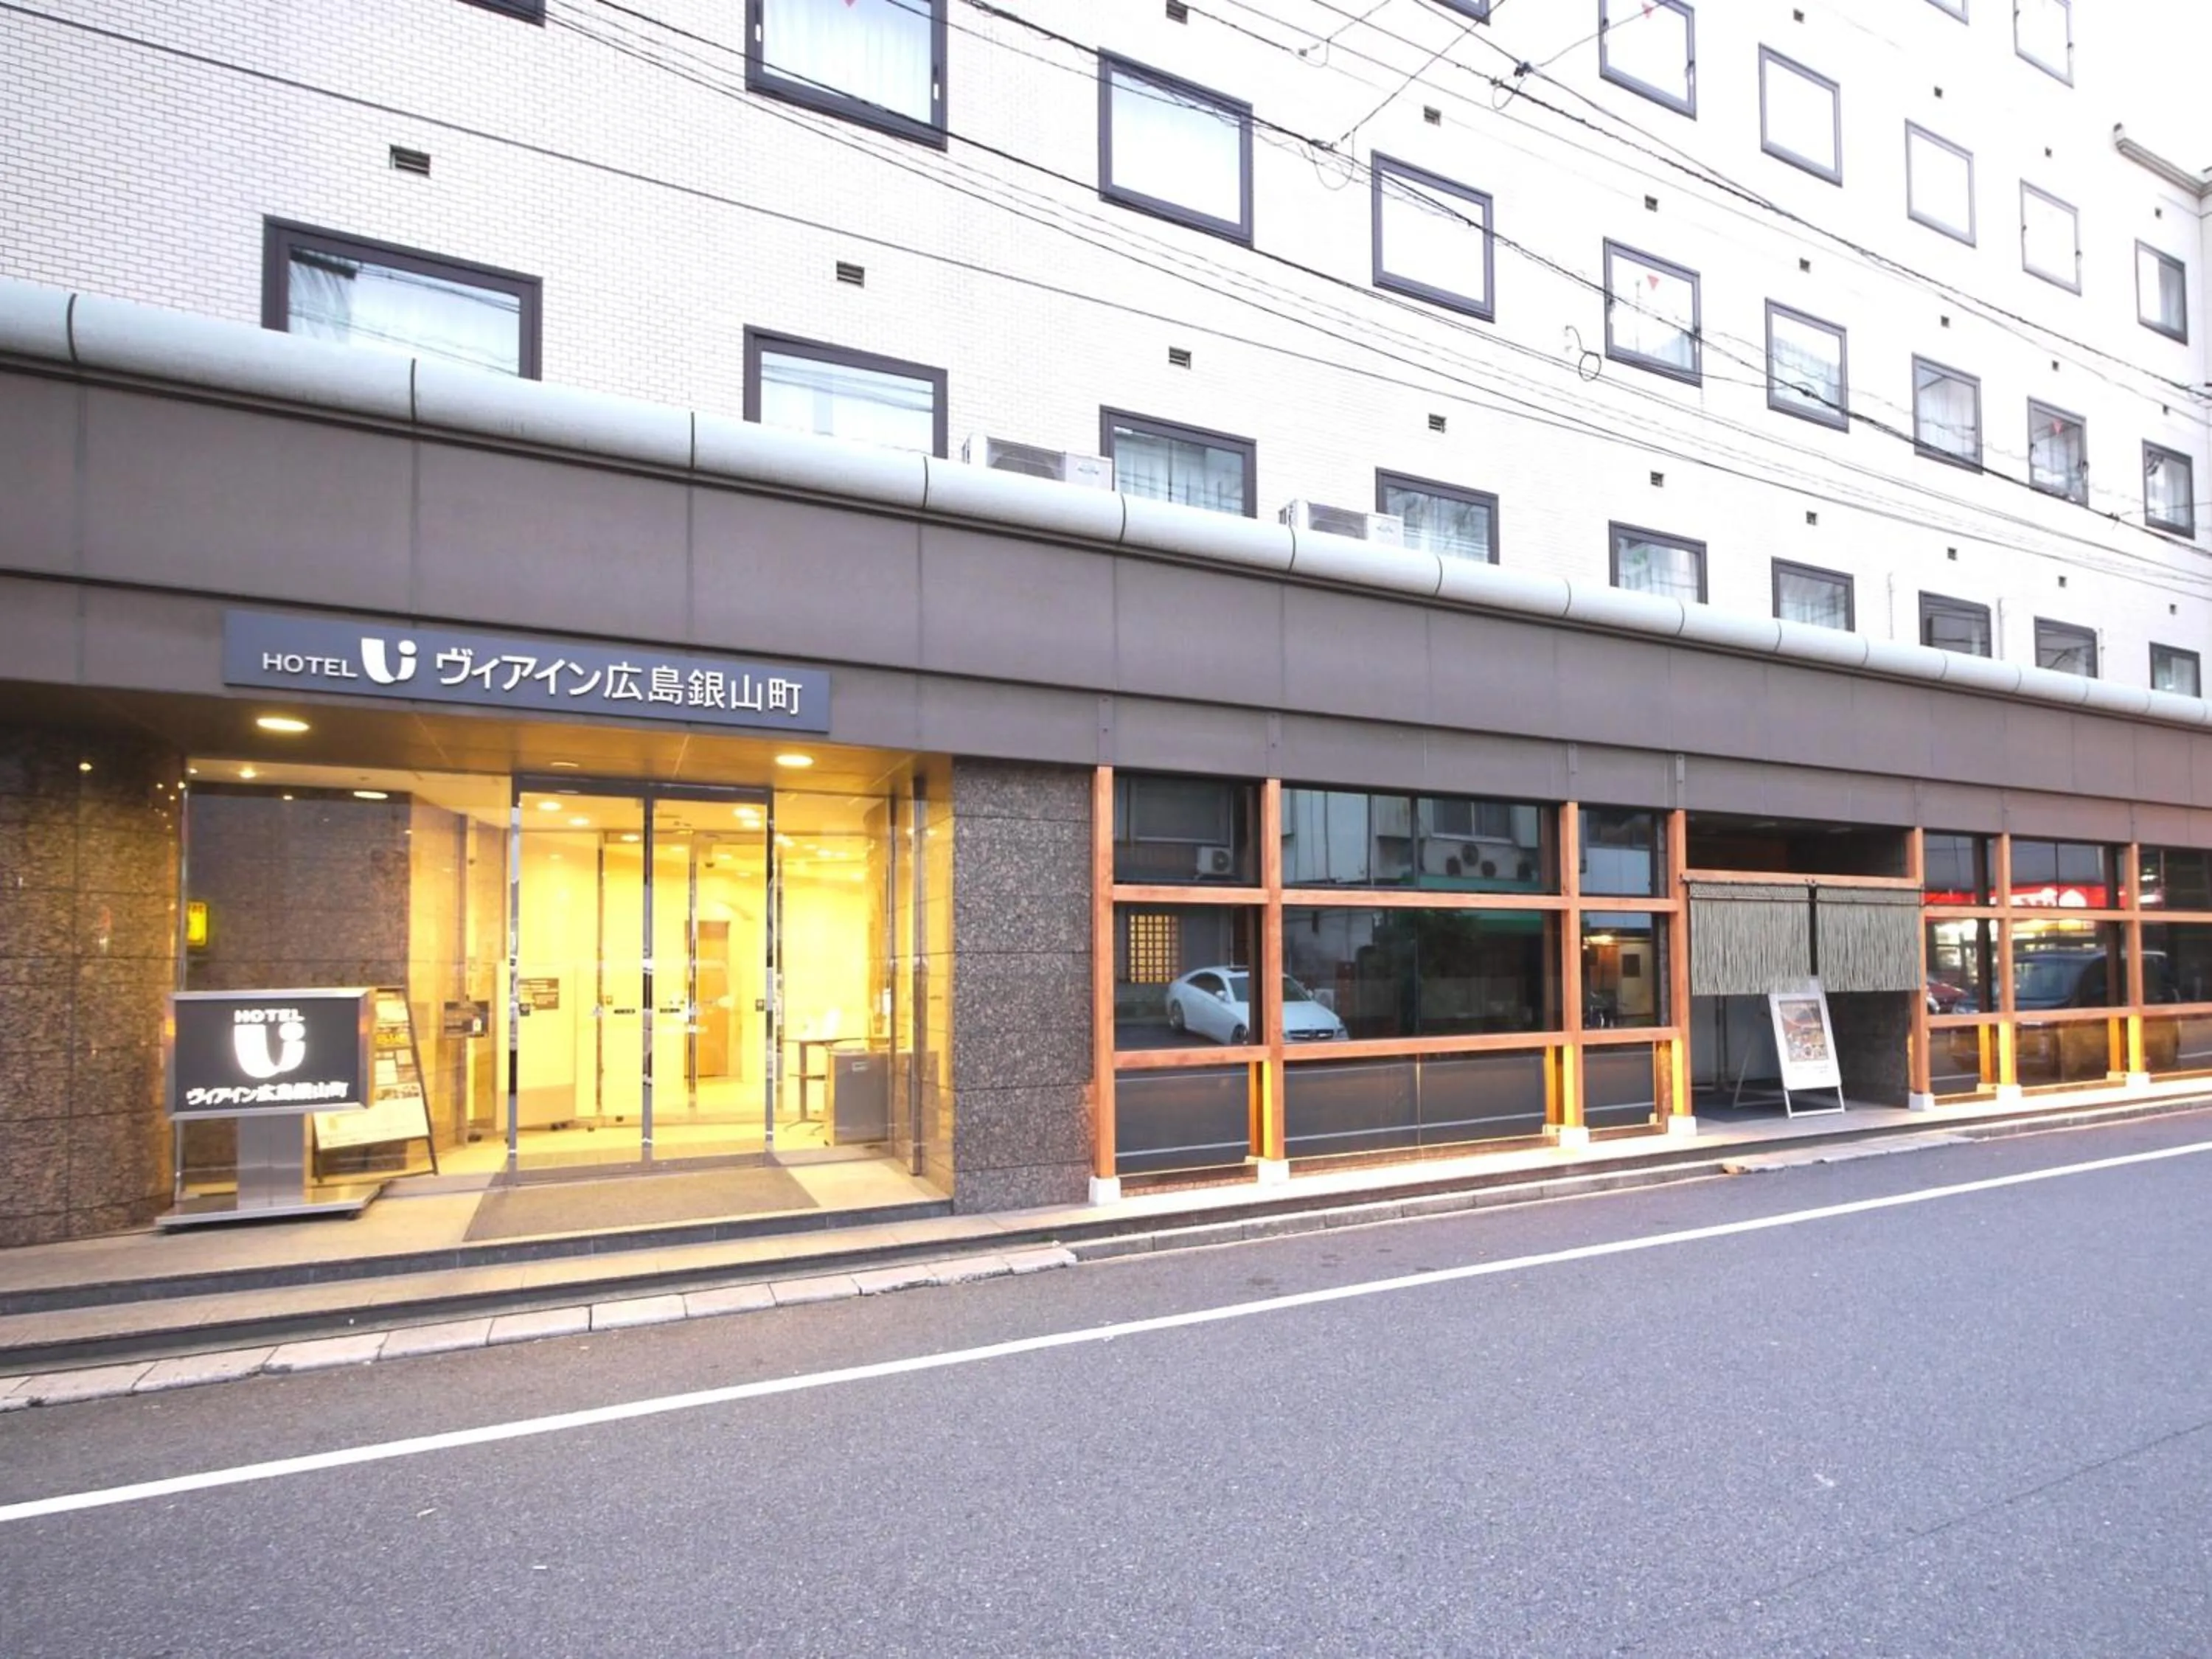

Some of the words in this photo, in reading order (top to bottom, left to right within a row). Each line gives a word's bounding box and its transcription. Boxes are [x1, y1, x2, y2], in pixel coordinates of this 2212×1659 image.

[262, 652, 358, 678] HOTEL
[436, 647, 804, 715] ヴィアイン広島銀山町
[234, 1008, 305, 1023] HOTEL
